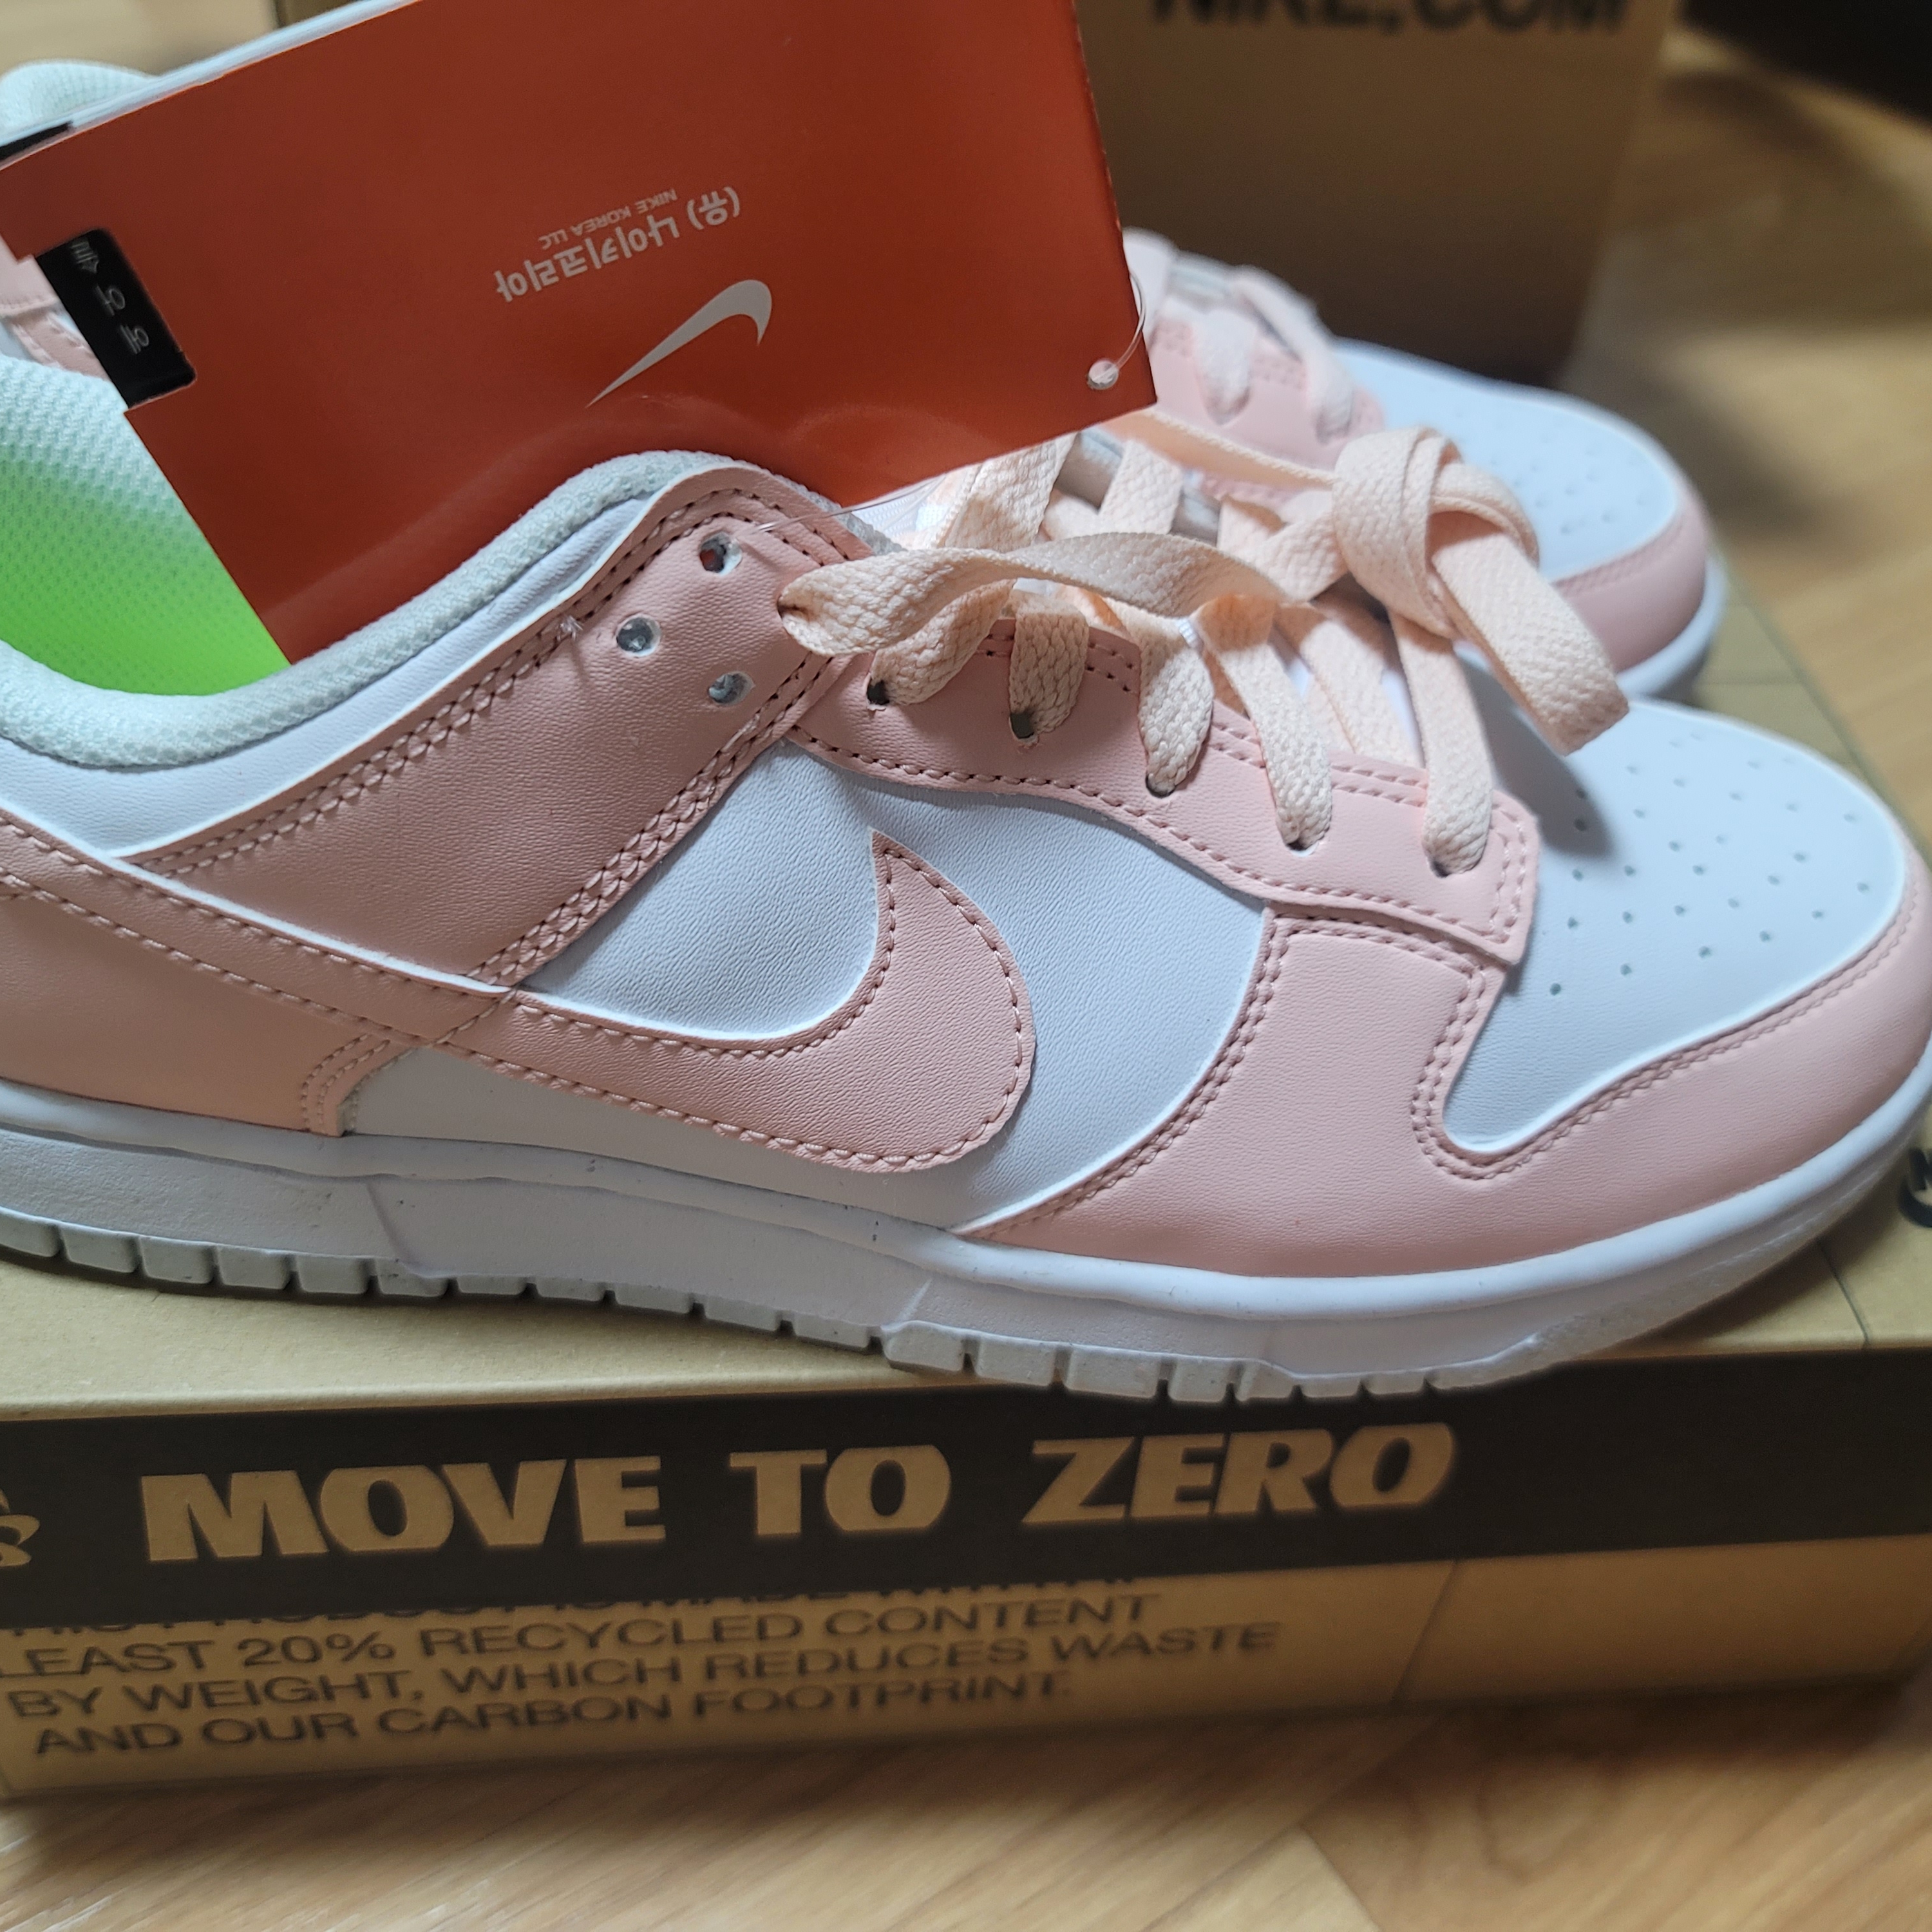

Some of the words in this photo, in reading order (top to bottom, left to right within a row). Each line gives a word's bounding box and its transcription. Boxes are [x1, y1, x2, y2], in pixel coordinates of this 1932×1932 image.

[571, 205, 632, 236] KOREA
[635, 188, 678, 214] NIKE
[687, 186, 741, 231] (유)
[494, 214, 680, 303] 나이키코리아
[538, 227, 569, 250] LLC
[141, 1455, 666, 1562] MOVE
[729, 1444, 951, 1537] TO
[1023, 1422, 1455, 1524] ZERO
[237, 1631, 396, 1667] 20%
[419, 1614, 804, 1656] RECYCLED
[825, 1593, 1159, 1636] CONTENT
[7, 1686, 102, 1718] BY
[122, 1670, 424, 1712] WEIGHT,
[441, 1657, 681, 1694] WHICH
[706, 1636, 1030, 1680] REDUCES
[1051, 1621, 1281, 1663] WASTE
[37, 1723, 183, 1754] AND
[201, 1712, 358, 1743] OUR
[378, 1695, 672, 1734] CARBON
